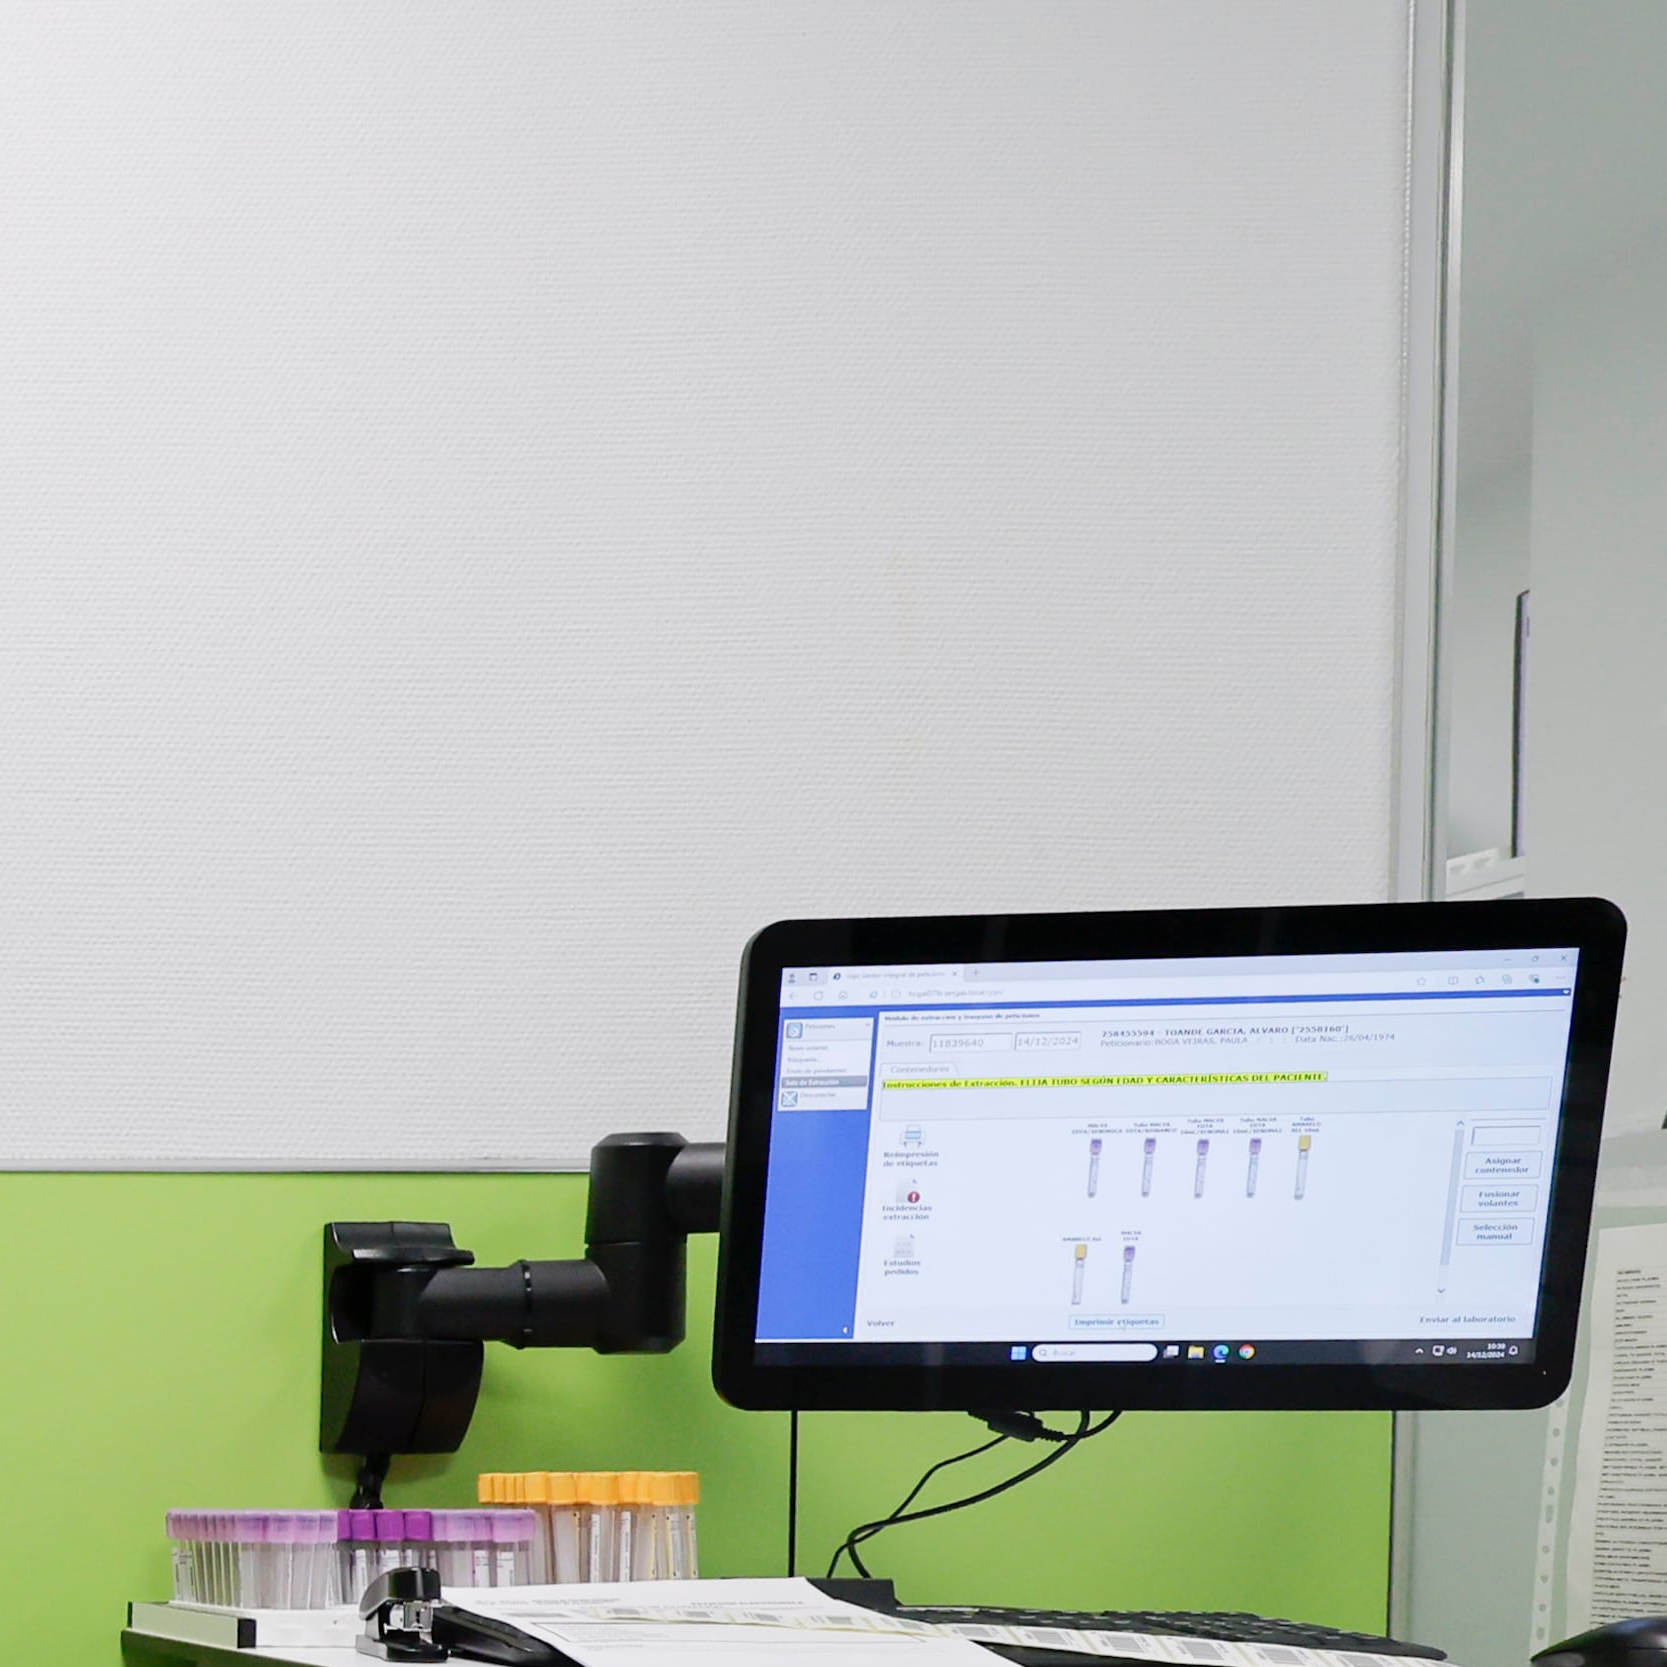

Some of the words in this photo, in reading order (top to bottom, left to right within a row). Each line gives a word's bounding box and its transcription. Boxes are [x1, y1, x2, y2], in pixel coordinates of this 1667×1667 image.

[1249, 1027, 1289, 1035] ALVARO
[1219, 1036, 1248, 1045] PAULA
[1295, 1035, 1317, 1044] Data
[890, 1065, 950, 1074] Contenedores
[882, 1080, 947, 1089] Instrucciones
[949, 1079, 961, 1088] de
[964, 1078, 1017, 1088] Extracción.
[1051, 1078, 1078, 1086] TUBO
[1080, 1075, 1114, 1085] SEGÚN
[1116, 1076, 1144, 1085] EDAD
[1146, 1076, 1153, 1084] Y
[1155, 1073, 1249, 1083] CARACTERÍSTICAS
[1251, 1073, 1269, 1082] DEL
[883, 1150, 940, 1160] Reimpresión
[883, 1159, 894, 1167] de
[897, 1159, 938, 1169] etiquetas
[1485, 1156, 1522, 1167] Asignar
[1475, 1165, 1530, 1174] contenedor
[1478, 1190, 1521, 1198] Fusionar
[1478, 1199, 1519, 1208] volantes
[882, 1204, 933, 1213] Incidencias
[882, 1213, 930, 1221] extracción
[1473, 1222, 1519, 1232] Selección
[1476, 1232, 1513, 1241] manual
[883, 1259, 922, 1267] Estudios
[884, 1268, 920, 1277] pedidos
[866, 1319, 896, 1328] Volver
[1074, 1318, 1115, 1328] Imprimir
[1116, 1317, 1160, 1328] etiquetas
[1419, 1315, 1450, 1324] Enviar
[1452, 1315, 1462, 1323] al
[1463, 1314, 1517, 1323] laboratorio
